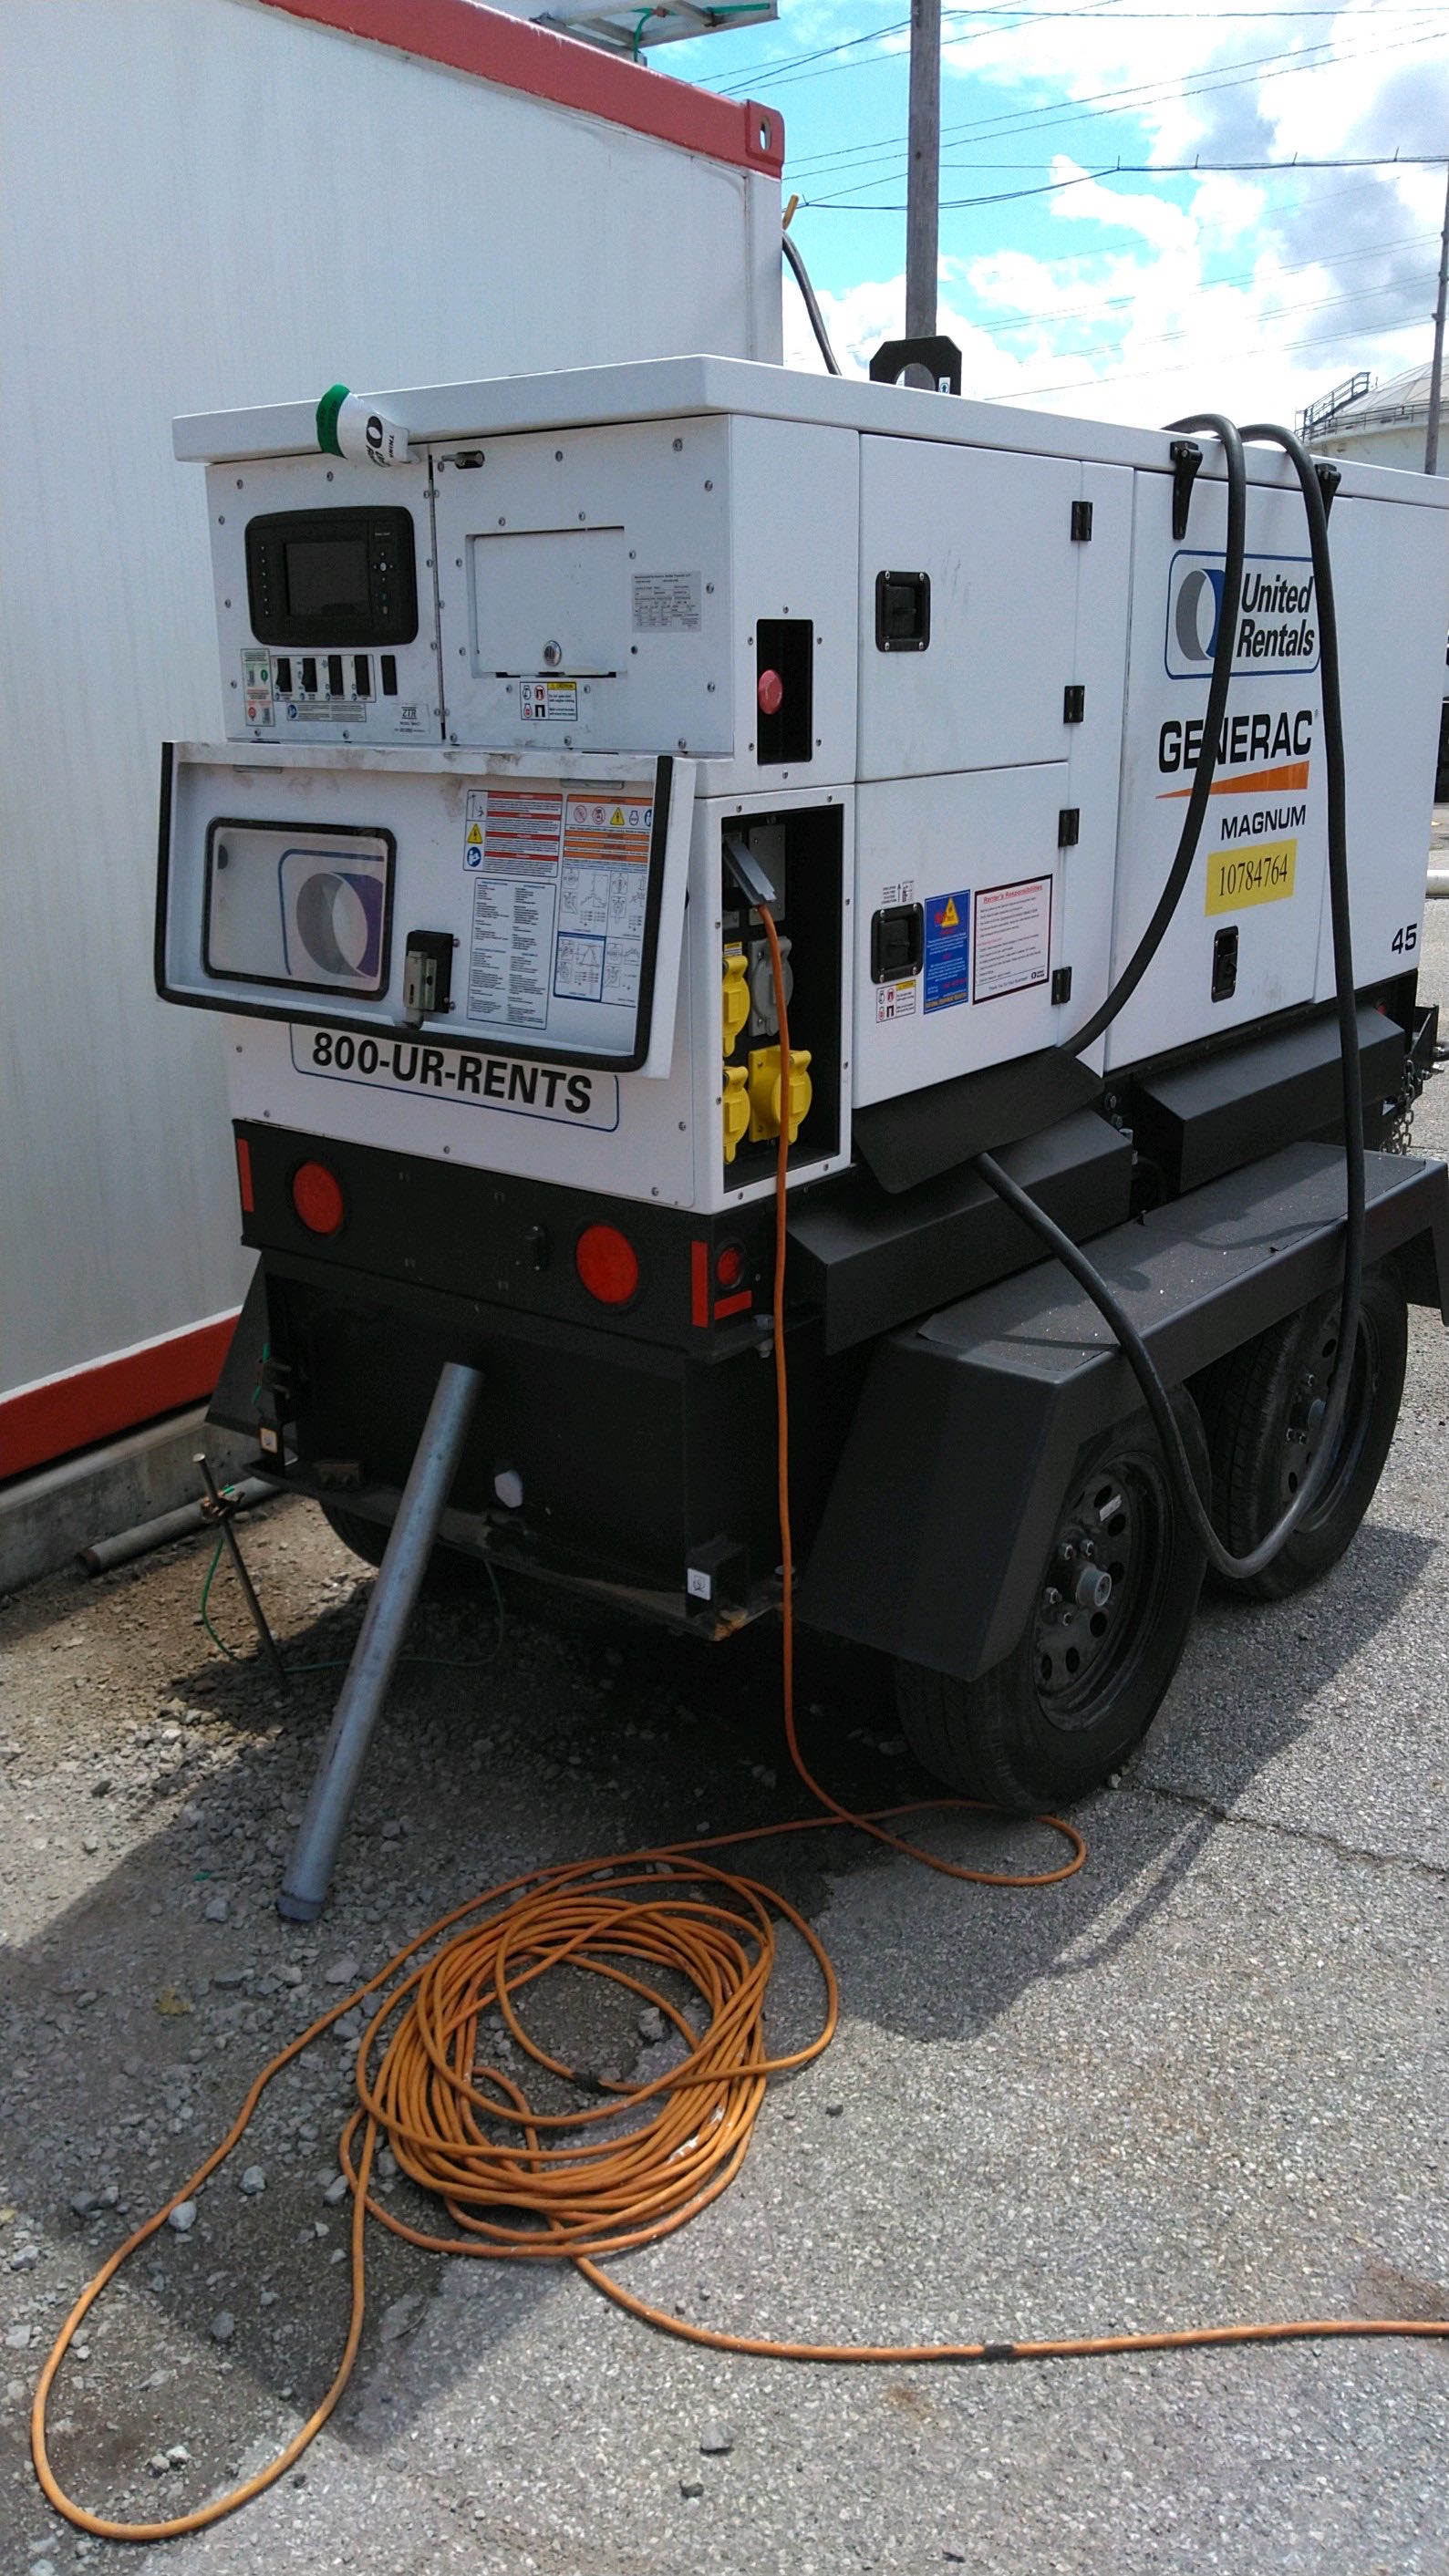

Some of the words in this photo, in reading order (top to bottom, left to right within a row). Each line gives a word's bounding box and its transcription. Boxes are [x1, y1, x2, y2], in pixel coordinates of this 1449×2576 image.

[1241, 573, 1314, 613] United
[1237, 618, 1315, 657] Rentals
[1159, 710, 1312, 773] GENERAC
[1221, 804, 1307, 841] MAGNUM
[1219, 853, 1288, 896] 10784764
[983, 894, 1004, 905] Renter's
[1392, 923, 1417, 954] 45
[312, 1032, 593, 1114] 800-UR-RENTS
